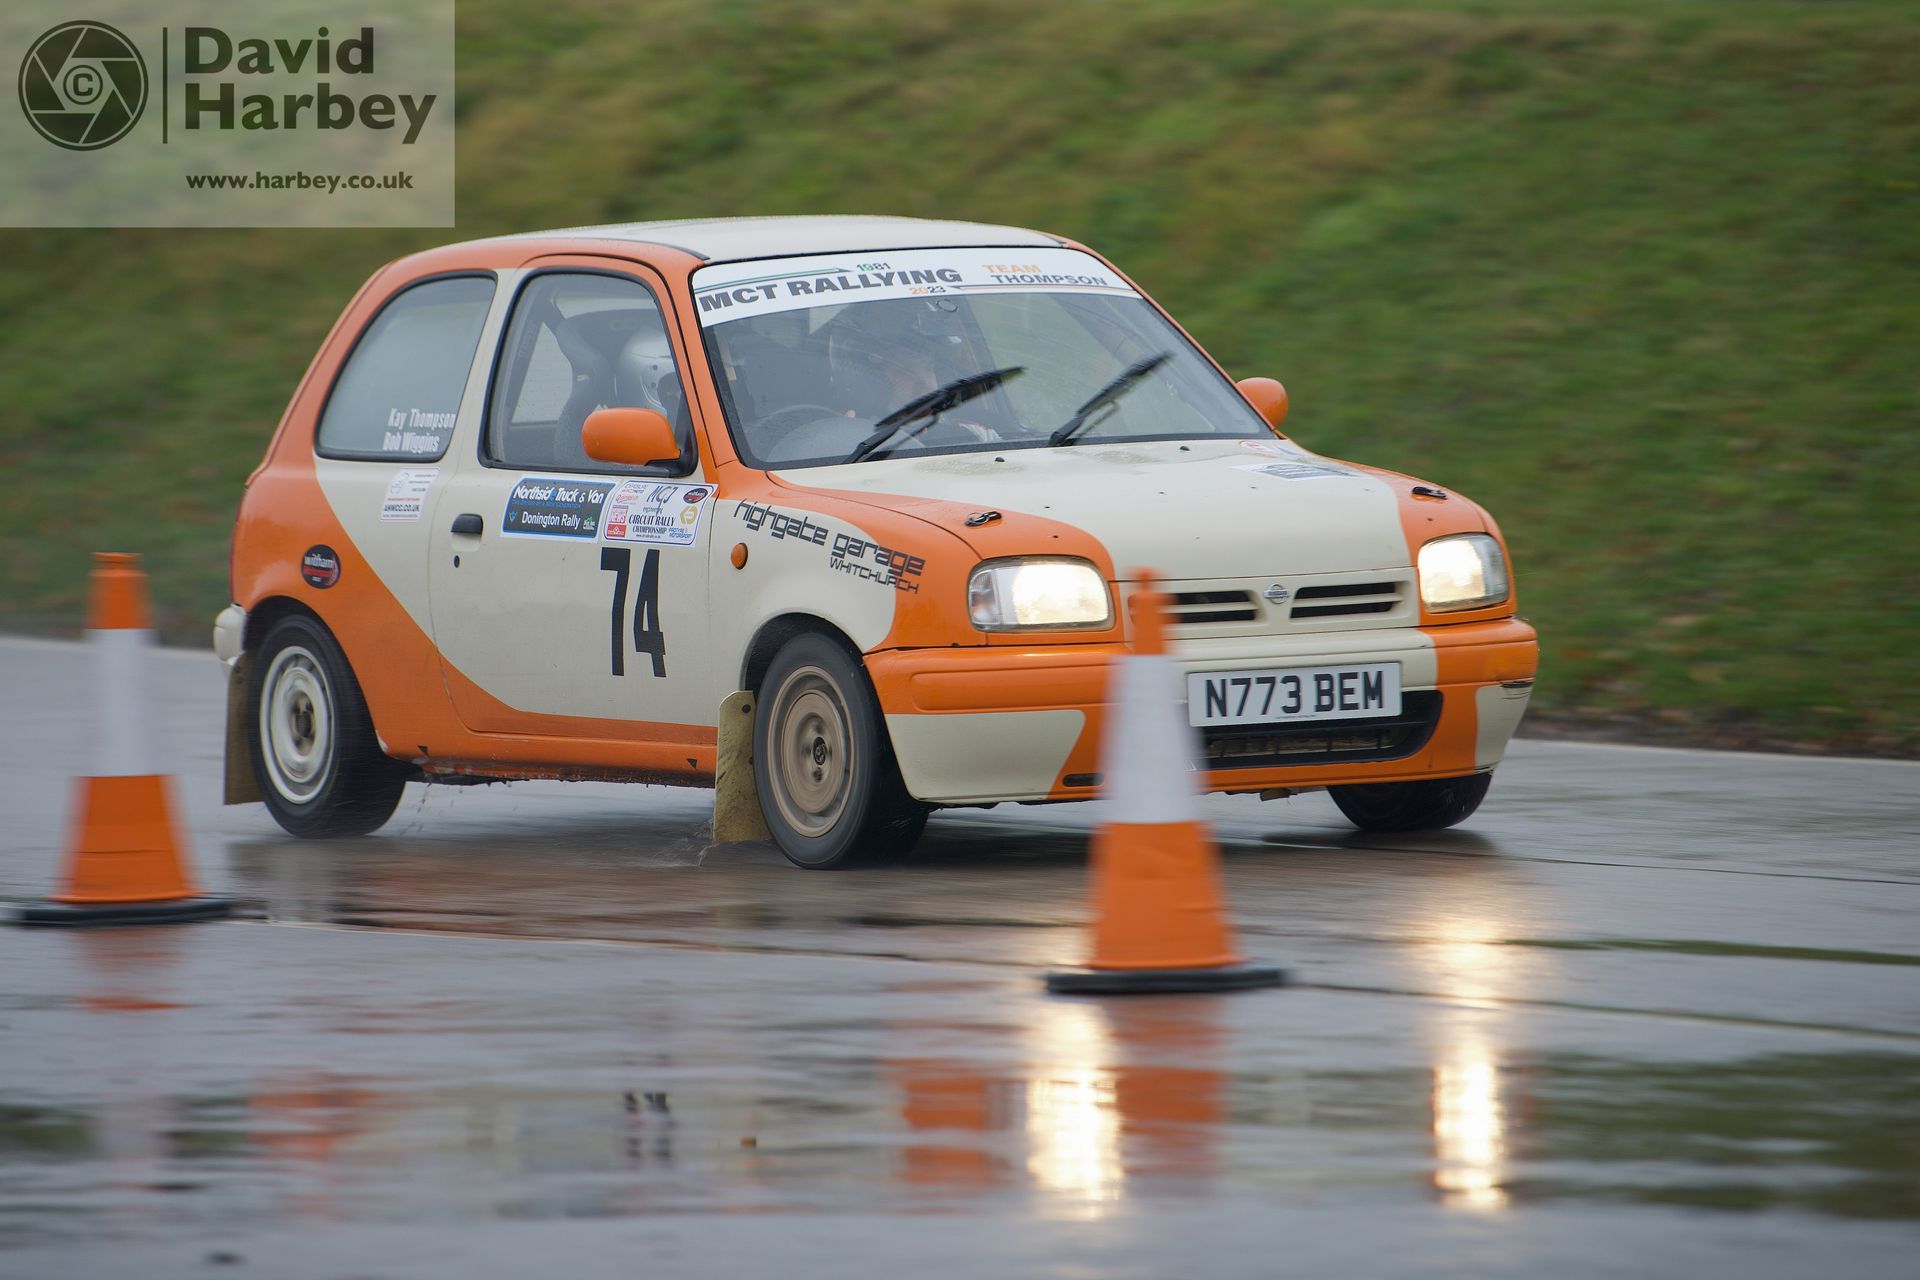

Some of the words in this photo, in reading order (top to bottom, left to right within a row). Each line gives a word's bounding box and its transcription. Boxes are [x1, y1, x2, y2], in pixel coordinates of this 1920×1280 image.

[856, 262, 891, 271] 1981
[982, 264, 1041, 274] TEAM
[991, 274, 1108, 286] THOMPSON
[699, 283, 778, 313] MCT
[786, 268, 963, 297] RALLYING
[909, 286, 946, 295] 2023
[409, 408, 457, 431] Thompson
[401, 432, 440, 454] Wiggins
[513, 486, 557, 501] Northside
[555, 487, 579, 502] Truck
[587, 489, 604, 504] Van
[521, 511, 560, 528] Donington
[561, 513, 581, 530] Rally
[629, 514, 655, 526] CIRCUIT
[655, 514, 676, 527] RALLY
[733, 498, 829, 546] highgate
[831, 533, 926, 577] garage
[829, 556, 920, 594] WHITCHURCH
[600, 547, 667, 677] 74
[1205, 675, 1301, 718] N773
[1313, 670, 1384, 713] BEM
